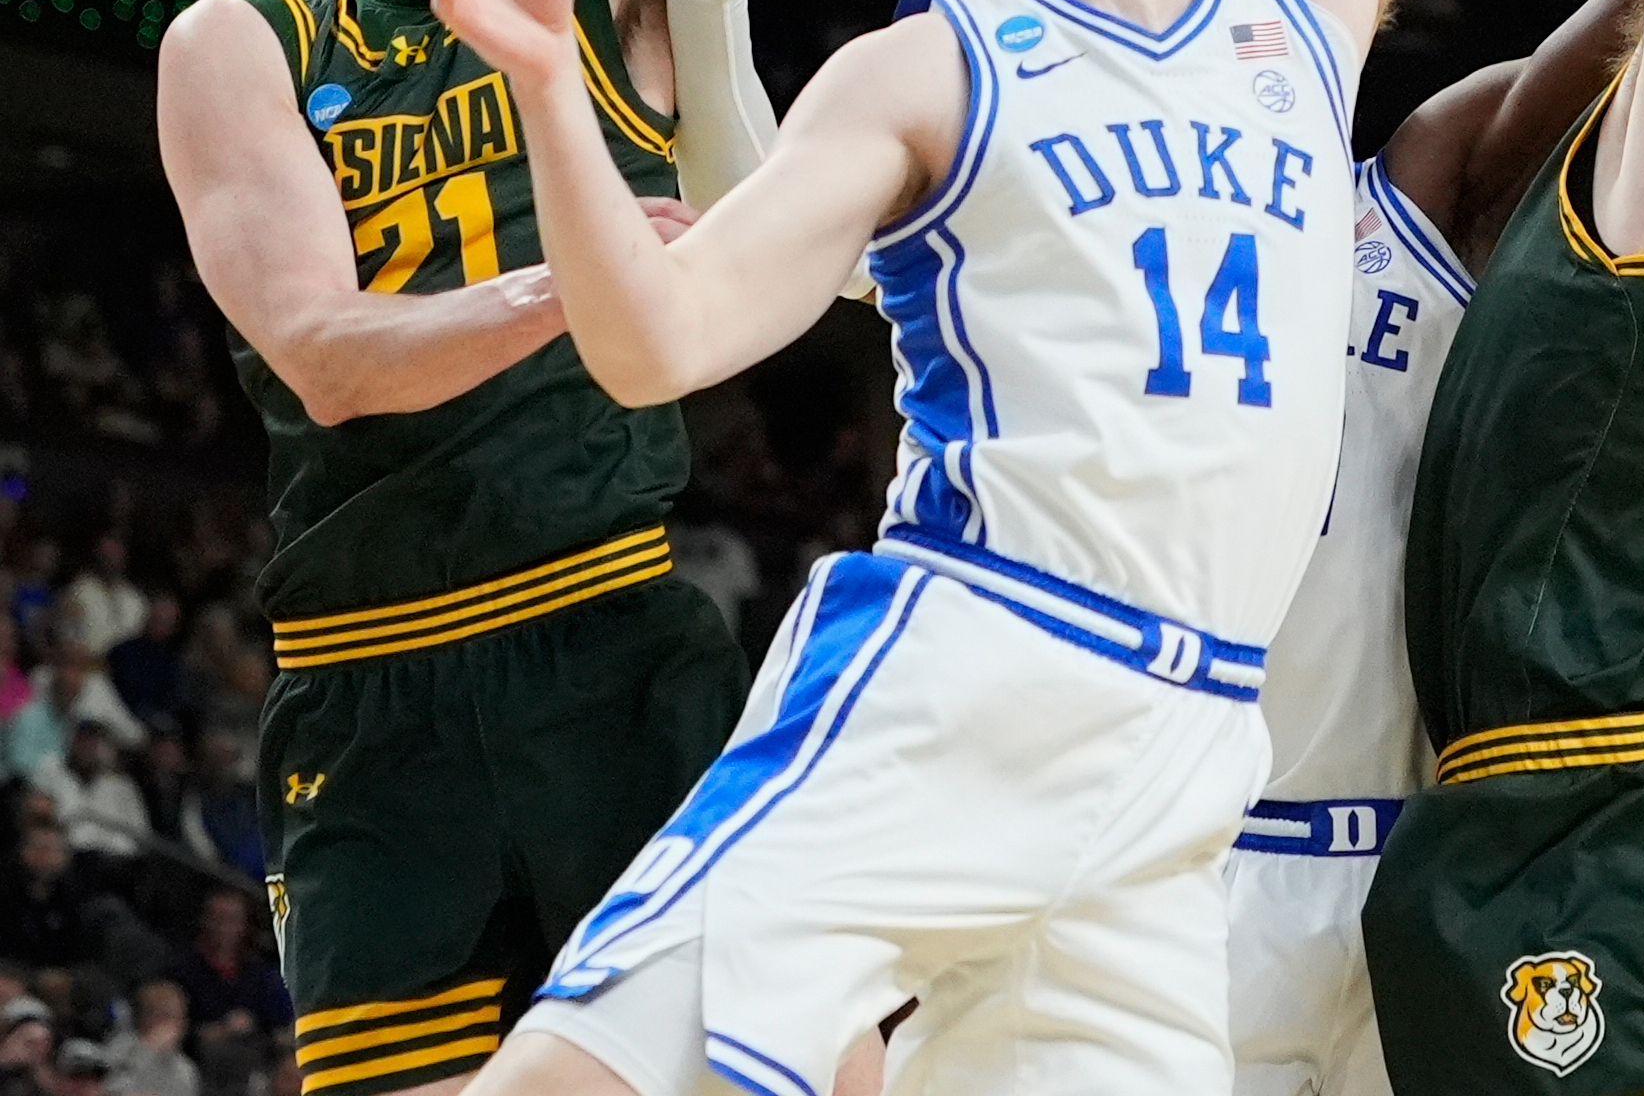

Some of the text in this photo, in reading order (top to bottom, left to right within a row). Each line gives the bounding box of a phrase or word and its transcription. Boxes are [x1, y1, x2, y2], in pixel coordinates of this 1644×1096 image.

[338, 81, 508, 202] SIENA
[1029, 119, 1314, 232] DUKE
[353, 171, 501, 295] 21
[1132, 227, 1272, 408] 14
[1147, 622, 1202, 685] D
[1327, 806, 1377, 853] D
